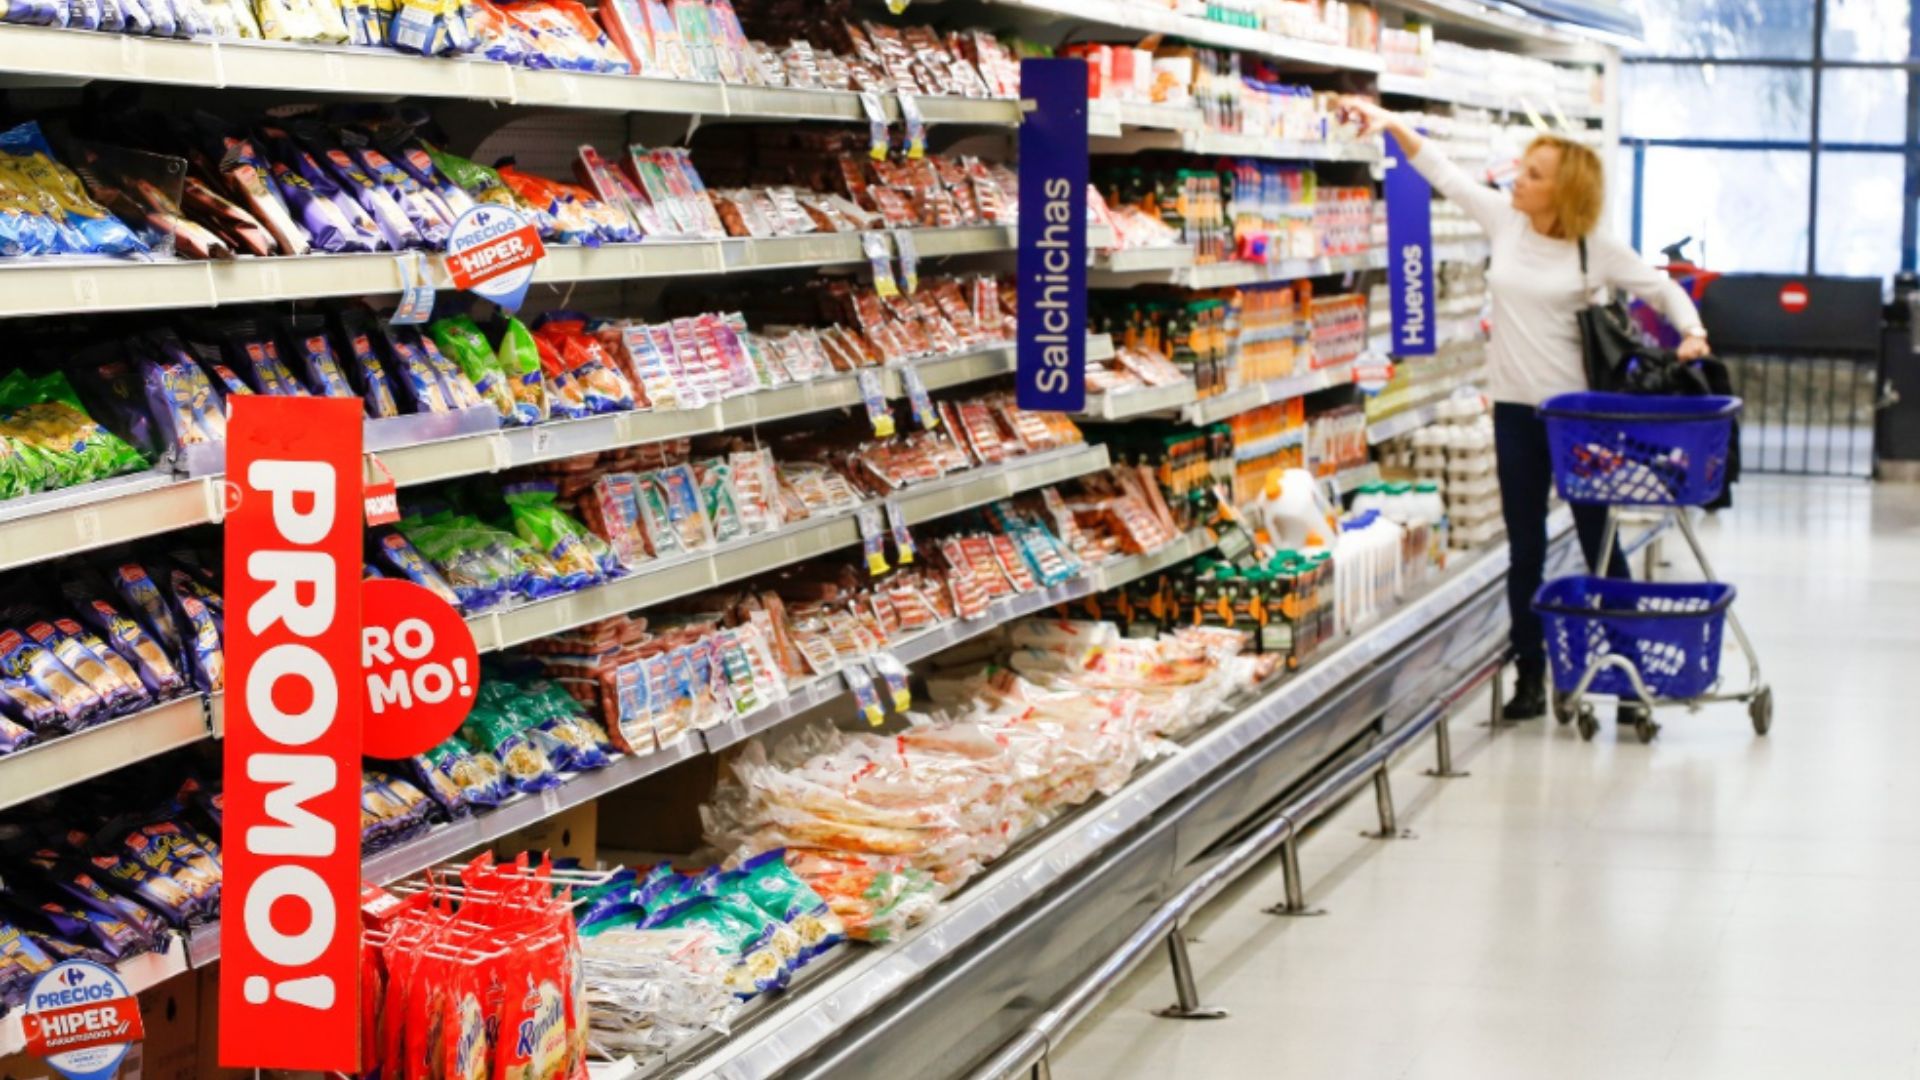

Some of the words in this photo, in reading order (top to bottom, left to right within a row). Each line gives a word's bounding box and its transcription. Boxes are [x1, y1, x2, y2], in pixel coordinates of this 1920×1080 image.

[461, 236, 525, 274] HIPER
[1034, 178, 1071, 394] Salchichas
[1402, 244, 1425, 345] Huevos
[361, 617, 435, 669] RO
[366, 656, 472, 714] MO!
[243, 459, 338, 1011] PROMO!
[41, 1007, 119, 1039] HIPER
